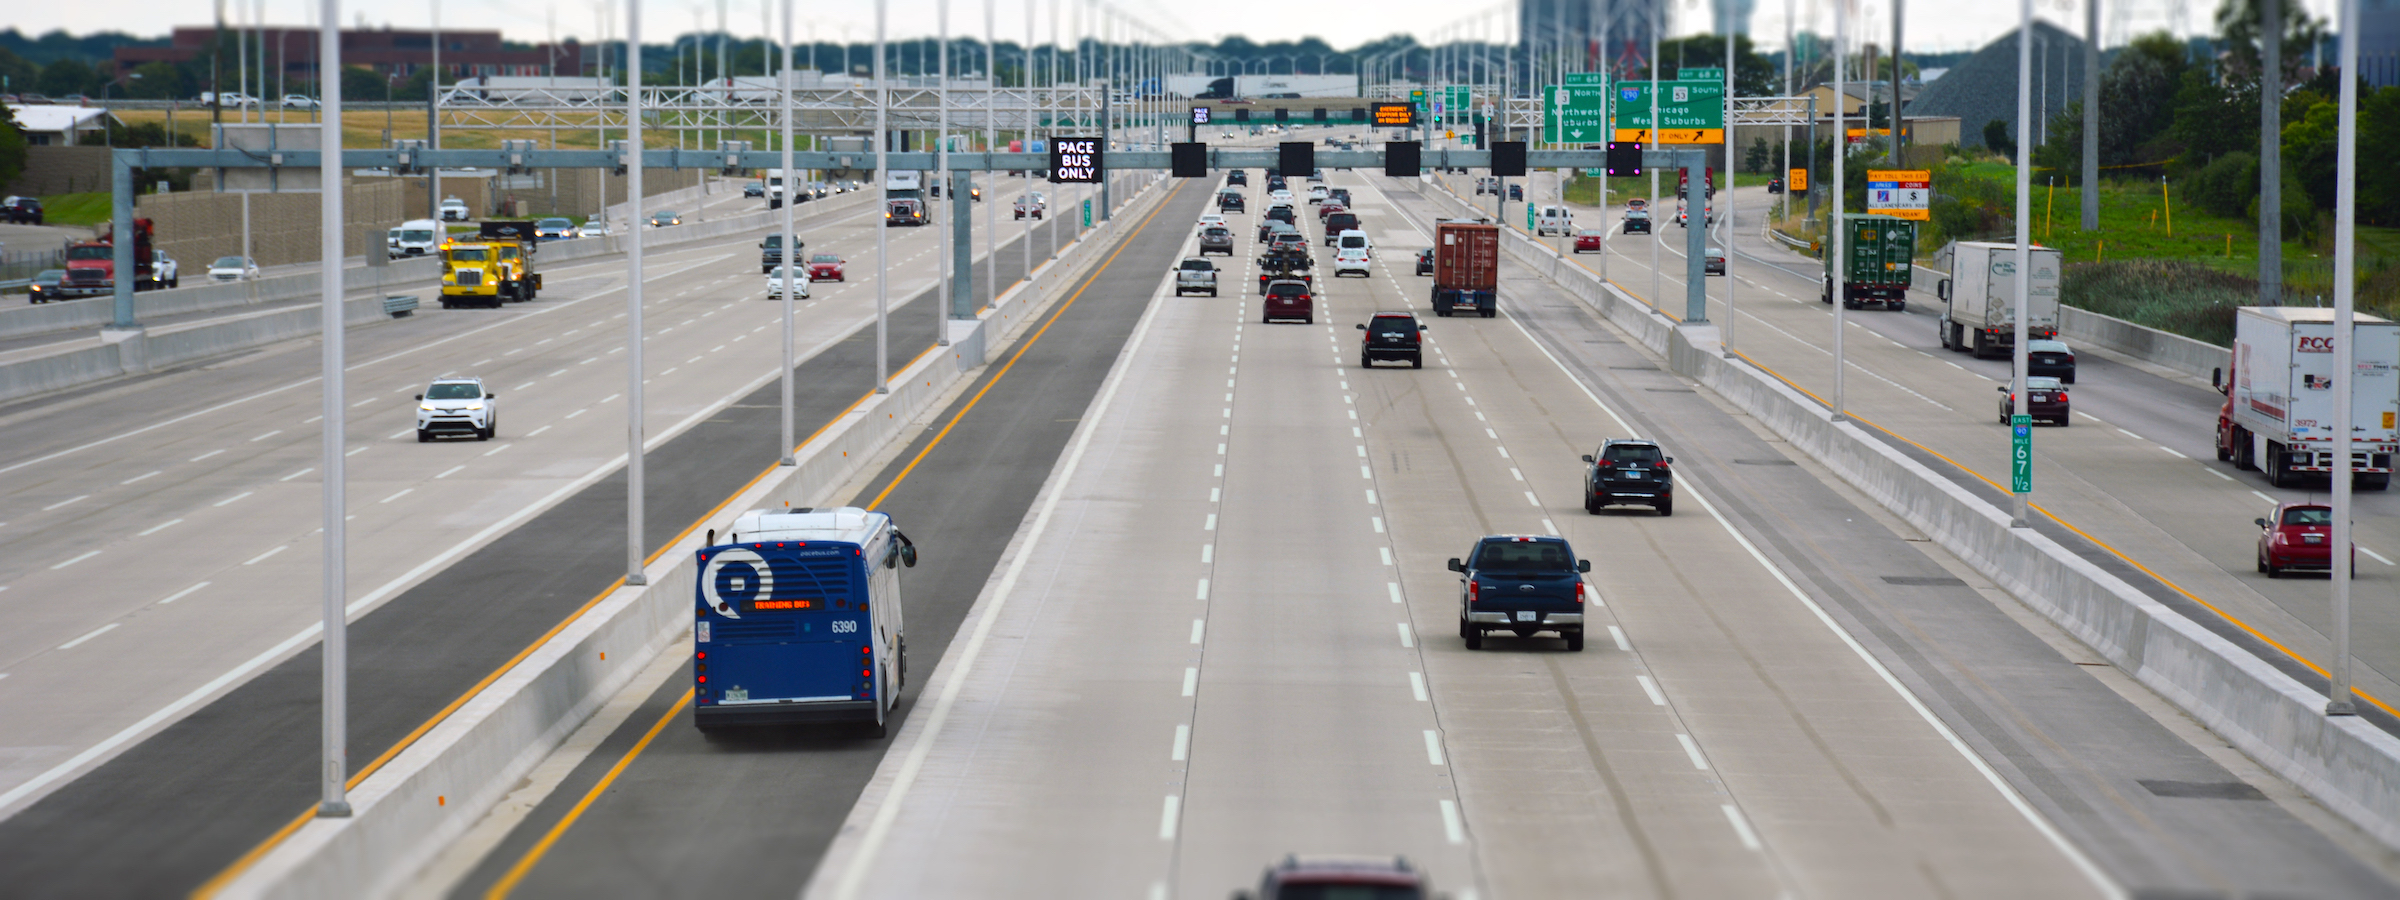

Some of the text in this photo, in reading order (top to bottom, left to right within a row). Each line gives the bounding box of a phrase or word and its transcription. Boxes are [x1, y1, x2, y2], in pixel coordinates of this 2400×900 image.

[1715, 71, 1722, 79] A
[1623, 91, 1639, 99] 290
[1692, 86, 1719, 95] SOUTH
[1675, 92, 1686, 101] 53
[1561, 118, 1599, 128] uburbs
[1631, 116, 1707, 126] Wes Suburbs
[1649, 132, 1665, 141] EIT
[1058, 141, 1095, 154] PACE
[1062, 155, 1091, 167] BUS
[1058, 168, 1095, 179] ONLY
[1793, 177, 1804, 185] 25
[2295, 418, 2317, 428] 3972
[2016, 445, 2027, 460] 6
[2016, 460, 2027, 475] 7
[754, 601, 793, 609] TRAINING
[831, 620, 857, 634] 6390
